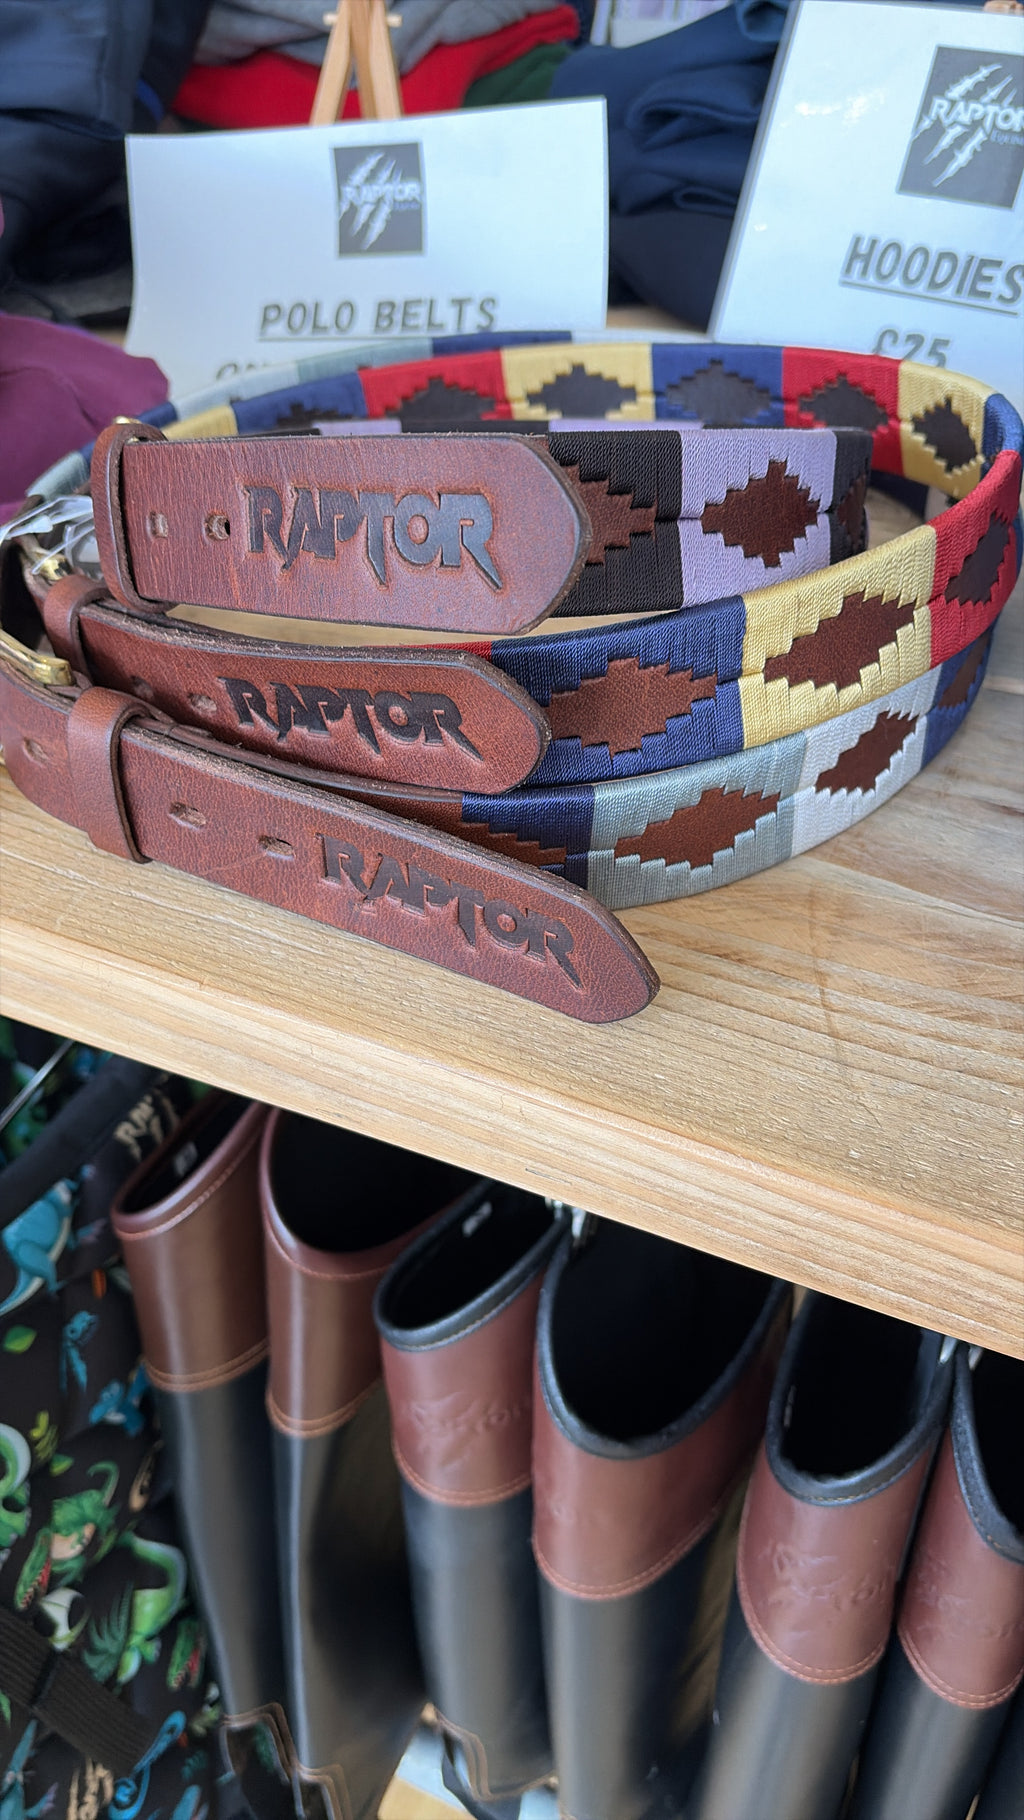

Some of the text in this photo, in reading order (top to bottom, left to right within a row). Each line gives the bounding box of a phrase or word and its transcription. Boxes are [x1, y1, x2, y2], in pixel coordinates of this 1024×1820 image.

[844, 235, 1024, 304] HOODIES
[260, 297, 497, 336] POLO BELTS
[243, 485, 502, 591] RAPTOR
[218, 676, 485, 763] RAPTOR
[317, 831, 583, 989] RAPTOR
